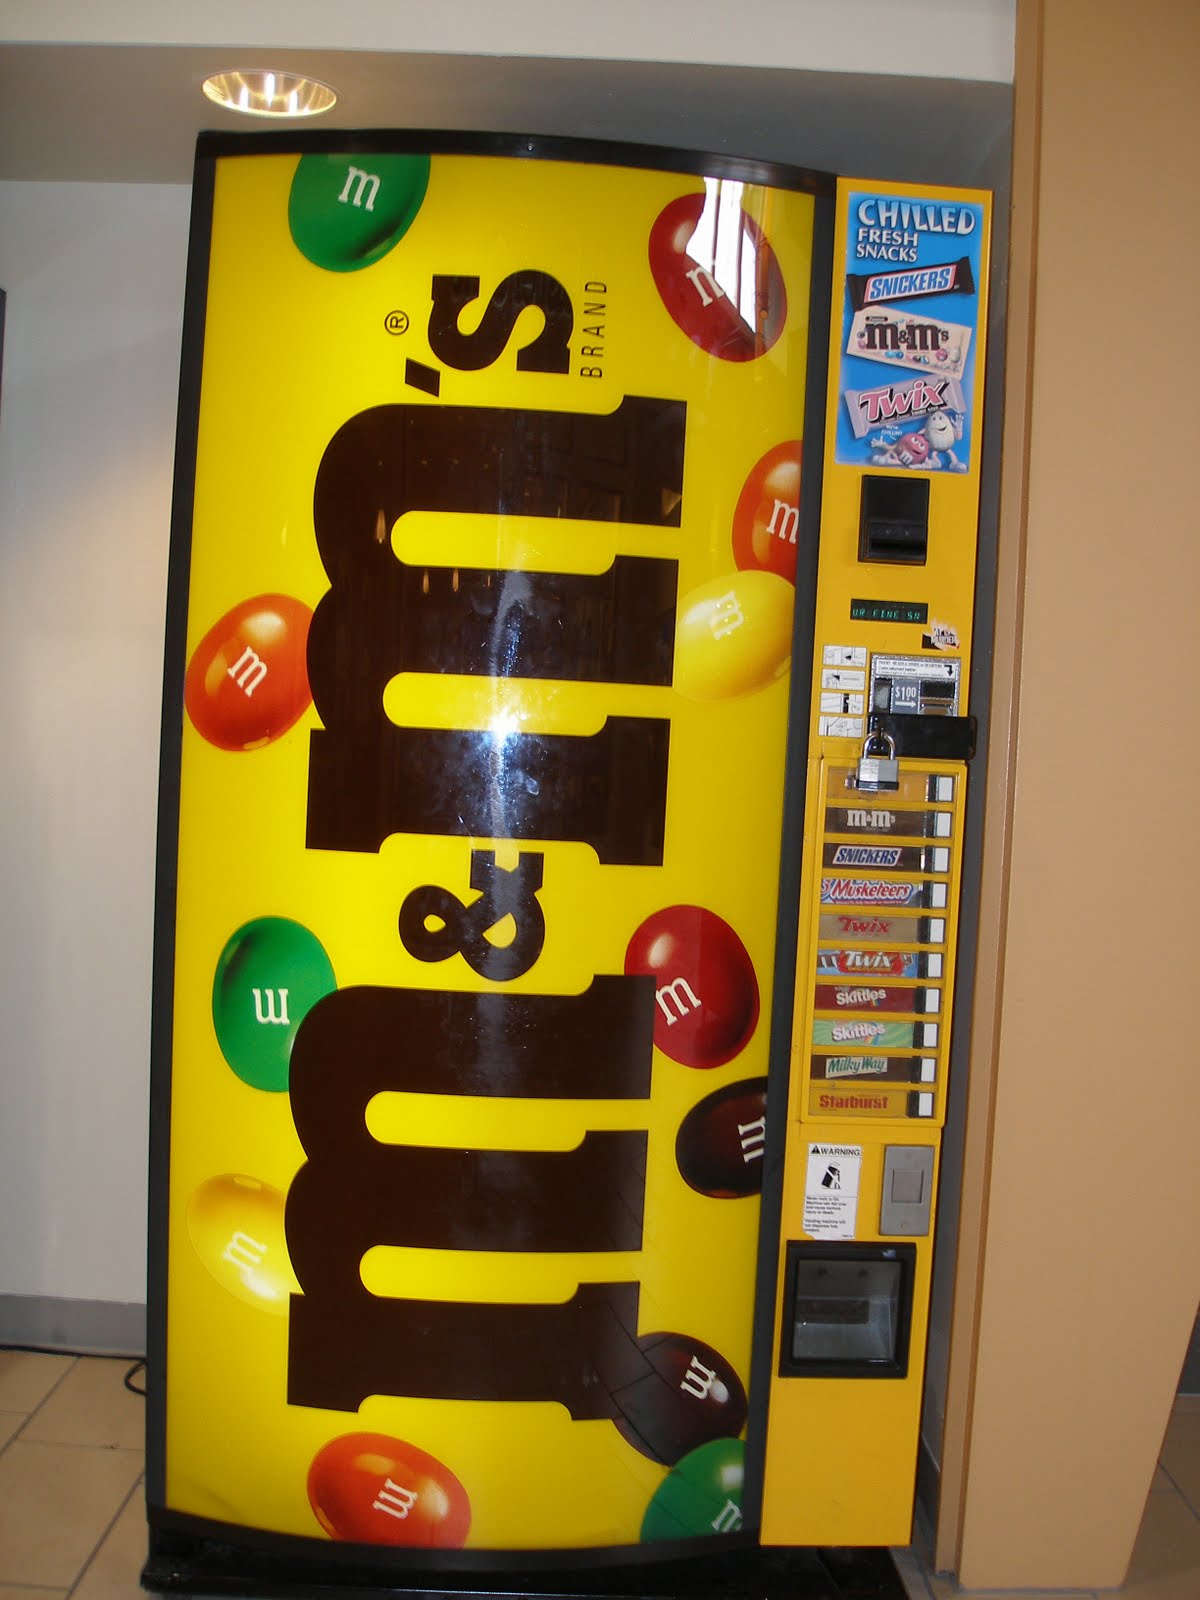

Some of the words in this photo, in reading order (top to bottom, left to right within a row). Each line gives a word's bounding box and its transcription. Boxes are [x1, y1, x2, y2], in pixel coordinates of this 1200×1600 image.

[858, 199, 975, 235] CHILLED
[858, 228, 919, 247] FRESH
[856, 243, 918, 263] SNACKS
[869, 267, 952, 299] SNICKERS
[580, 280, 608, 378] BRAND
[859, 380, 946, 423] Twix
[227, 645, 269, 696] m
[836, 848, 899, 865] SNICKERS
[831, 879, 911, 898] Musketeers
[838, 914, 896, 934] Twix
[844, 951, 897, 967] Twix
[836, 988, 887, 1006] Skittles
[832, 1024, 886, 1042] Skittles
[827, 1057, 862, 1074] Milky
[861, 1056, 886, 1072] Way
[819, 1094, 889, 1110] Starburst
[820, 1147, 861, 1157] WARNING
